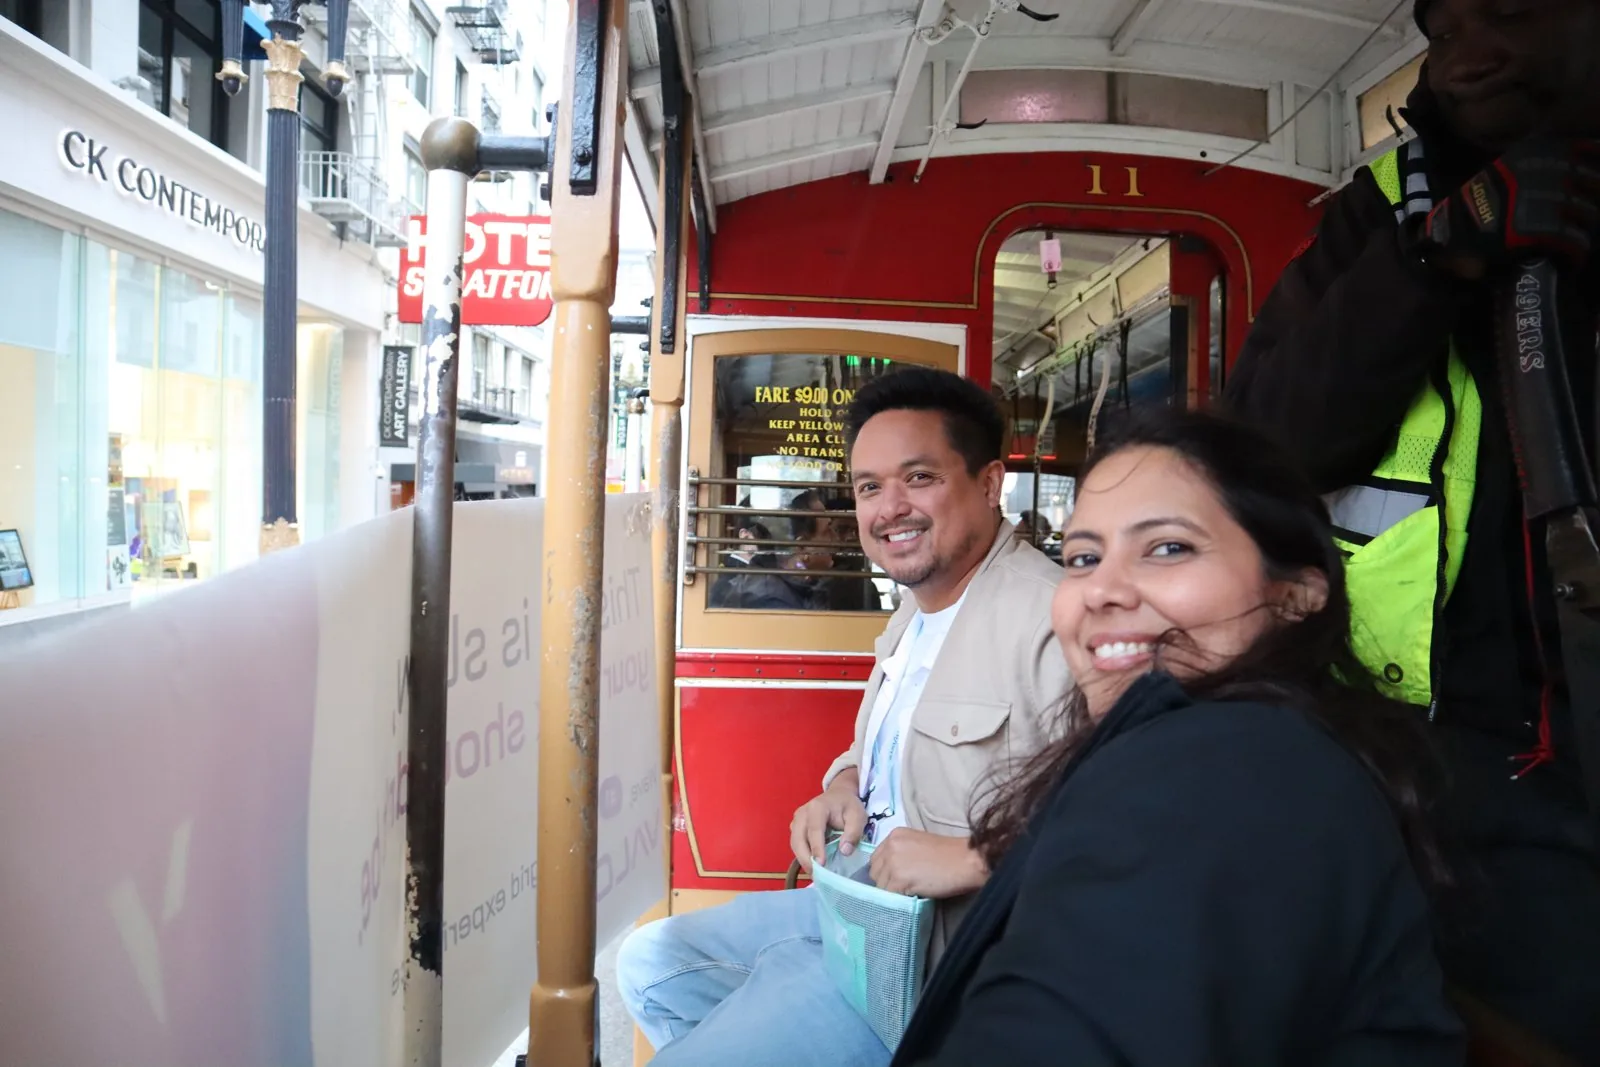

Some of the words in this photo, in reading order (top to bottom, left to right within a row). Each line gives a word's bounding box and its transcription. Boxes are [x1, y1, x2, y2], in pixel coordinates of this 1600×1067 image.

[63, 130, 108, 183] CK
[118, 158, 266, 252] CONTEMPOR
[1086, 164, 1145, 197] 11
[1516, 274, 1545, 373] 49ERS
[384, 351, 395, 424] CONTEMPORARY
[395, 350, 408, 410] GALLERY
[755, 386, 791, 403] FARE
[795, 386, 829, 405] $9.00
[799, 407, 833, 418] HOLD
[394, 412, 405, 440] ART
[769, 419, 796, 430] KEEP
[799, 420, 845, 432] YELLOW
[786, 432, 821, 443] AREA
[779, 446, 799, 456] NO
[803, 447, 848, 458] TRANS
[825, 461, 844, 472] OR
